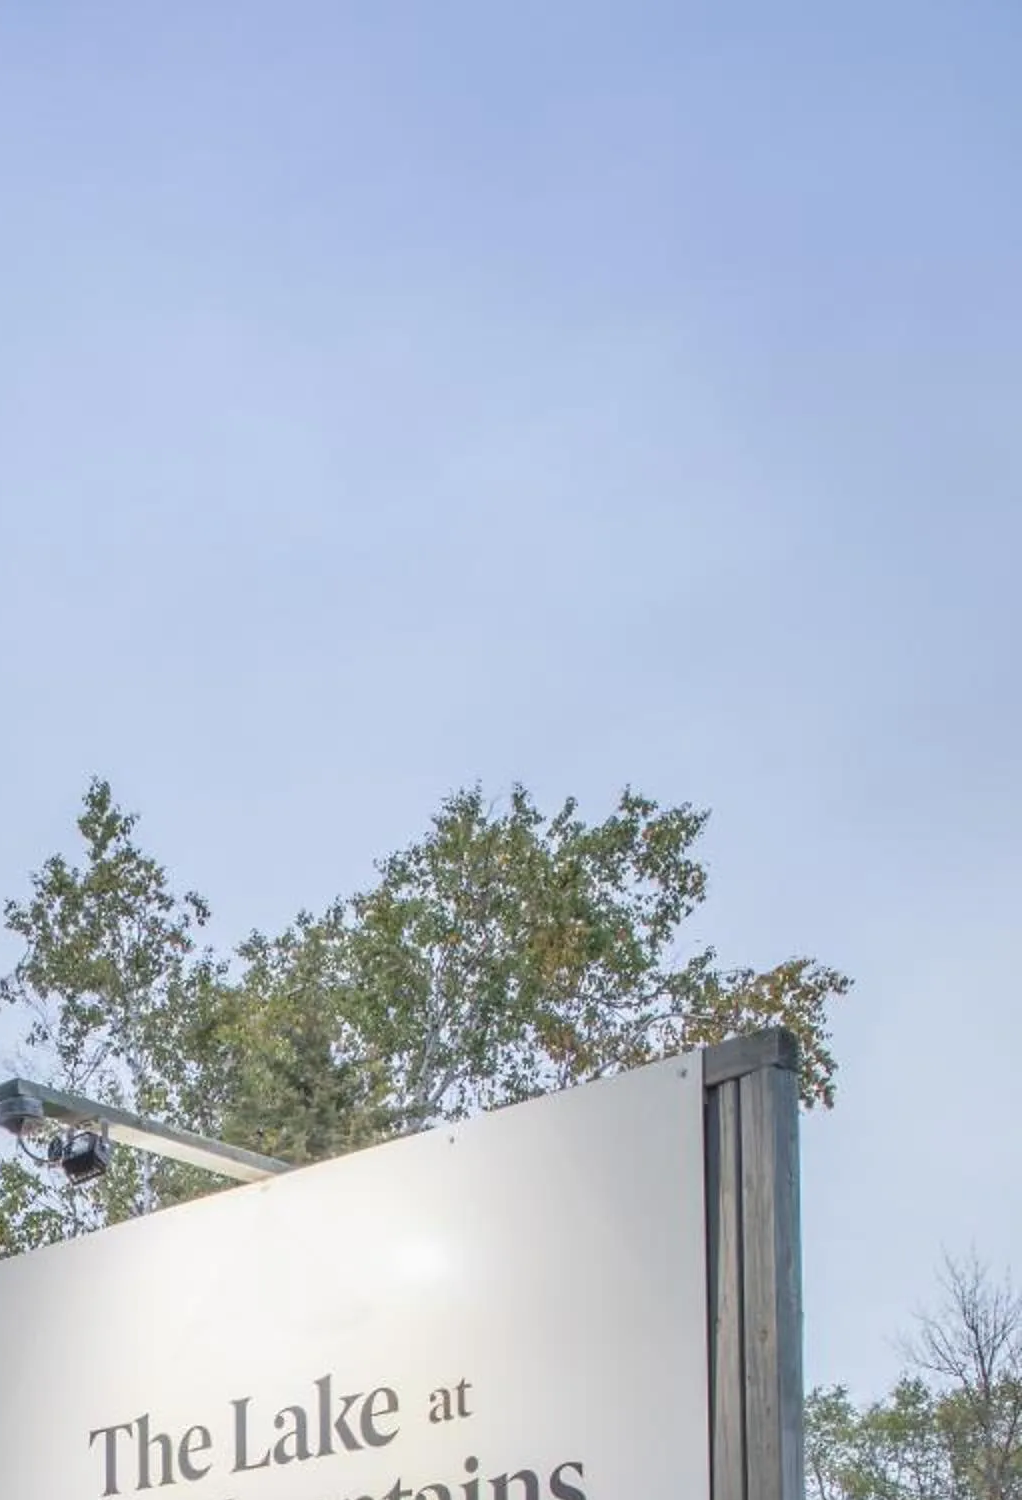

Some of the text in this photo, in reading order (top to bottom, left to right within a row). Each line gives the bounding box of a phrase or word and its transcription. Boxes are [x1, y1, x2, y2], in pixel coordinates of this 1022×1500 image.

[89, 1373, 473, 1497] The Lake at
